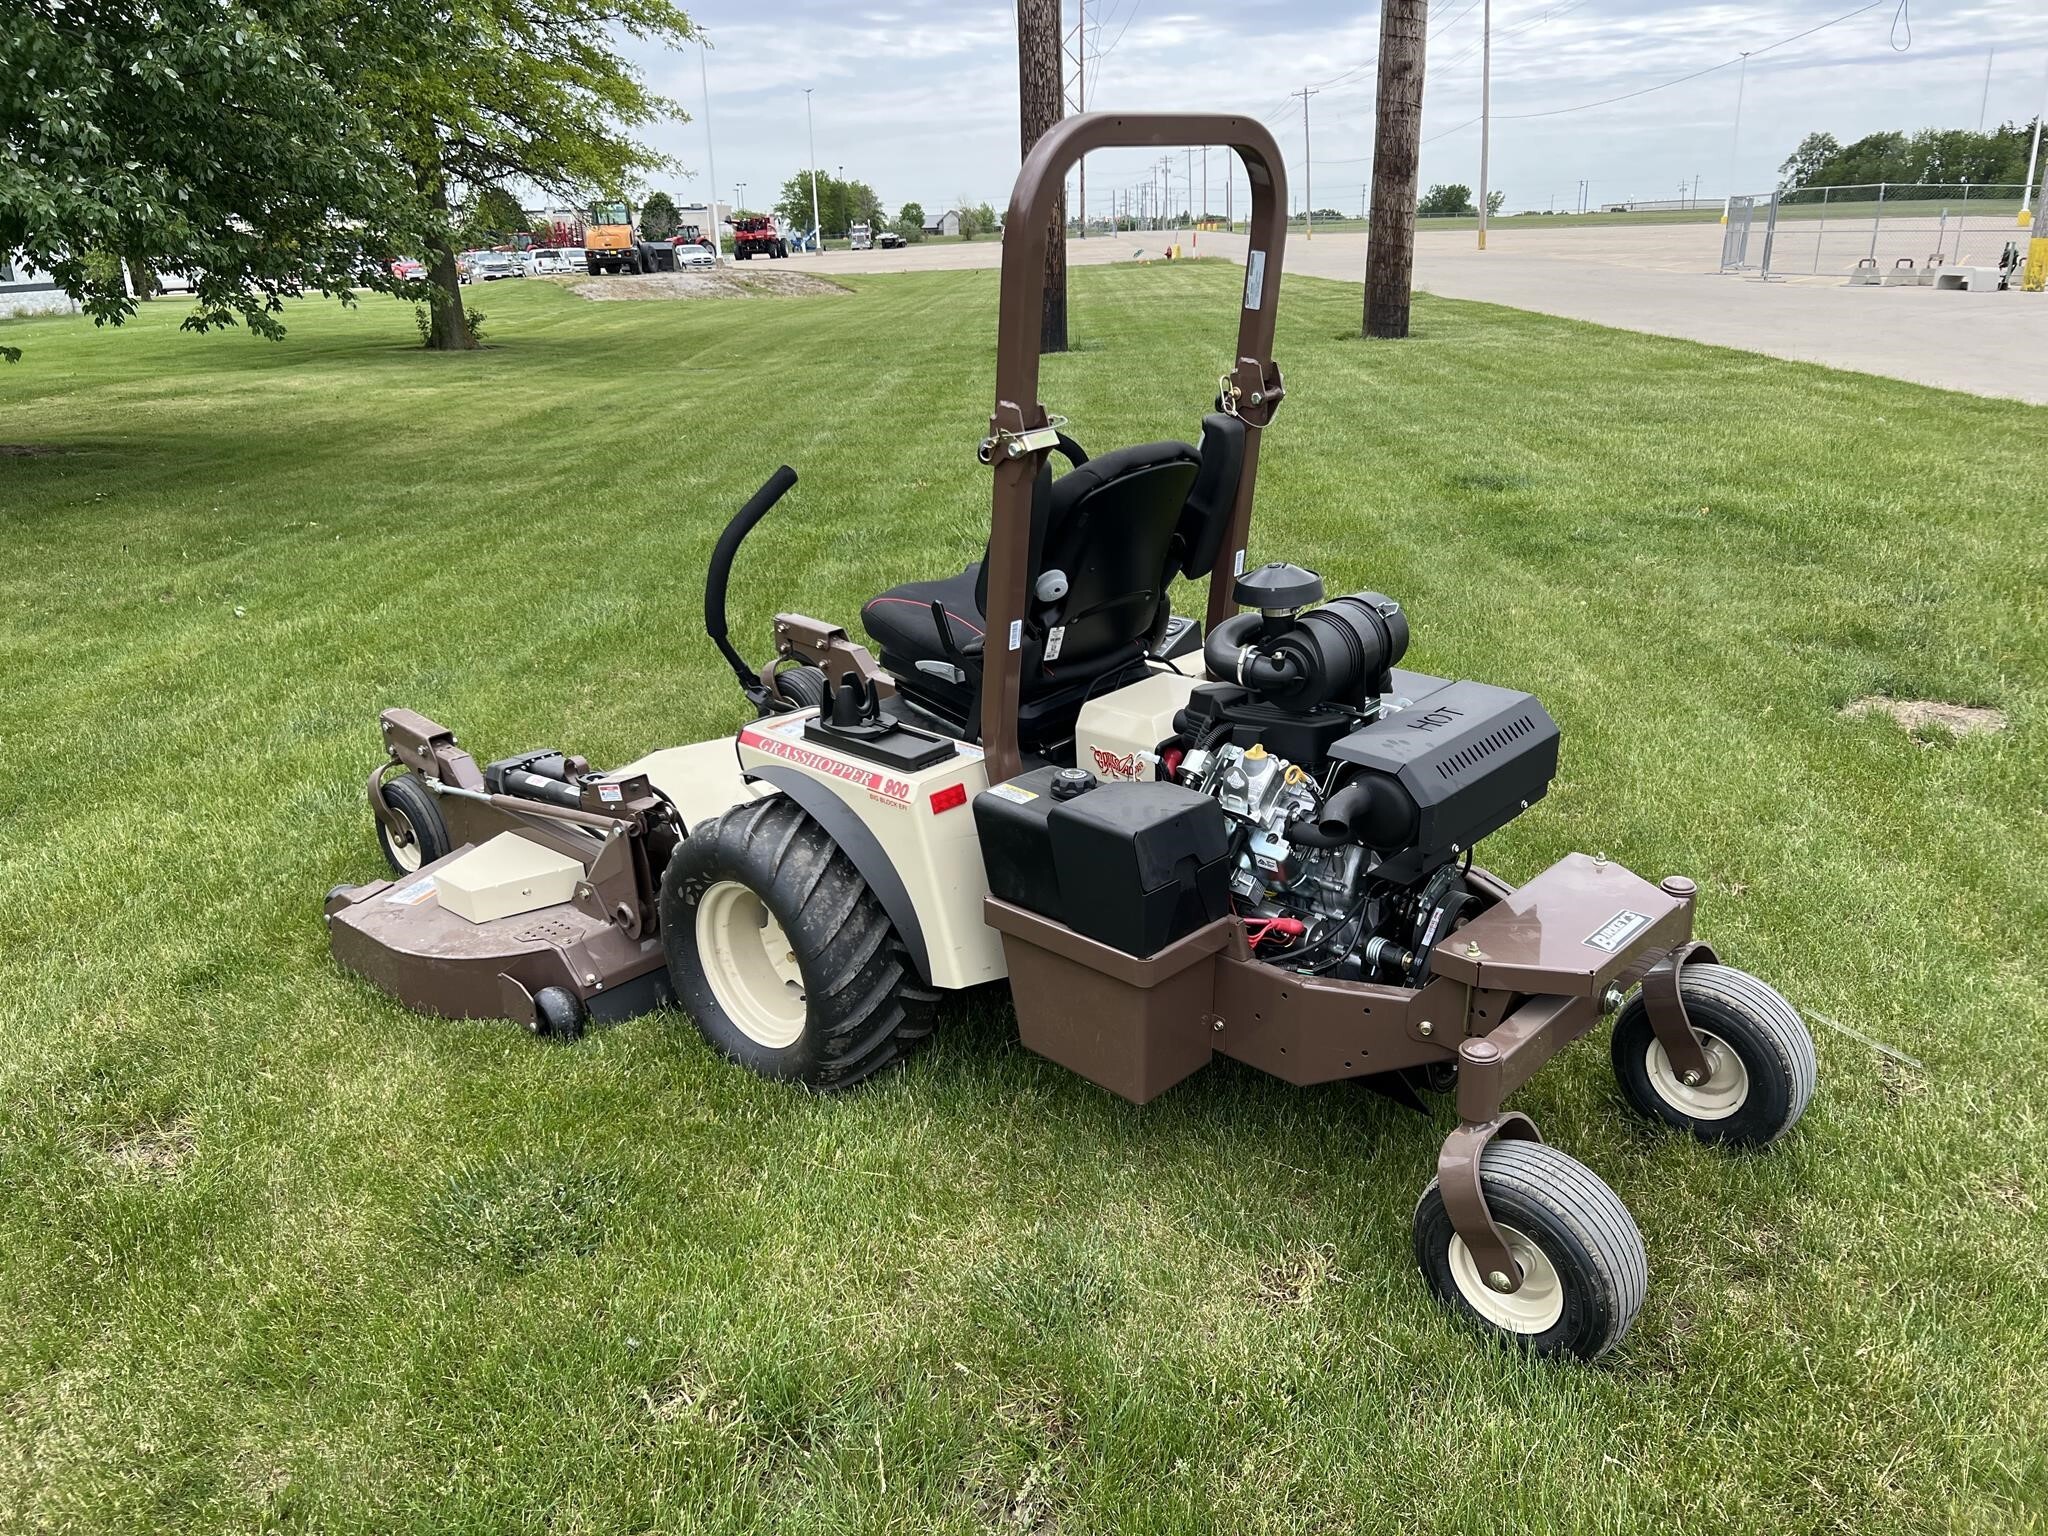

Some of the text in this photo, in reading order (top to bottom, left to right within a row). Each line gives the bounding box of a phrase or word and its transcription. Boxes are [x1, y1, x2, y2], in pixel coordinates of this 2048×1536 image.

[1407, 706, 1464, 732] HOT
[759, 738, 909, 798] GRASSHOPPER 900
[869, 793, 879, 802] BIG
[880, 797, 898, 807] BLOCK
[1591, 911, 1637, 951] BIRKEY'S
